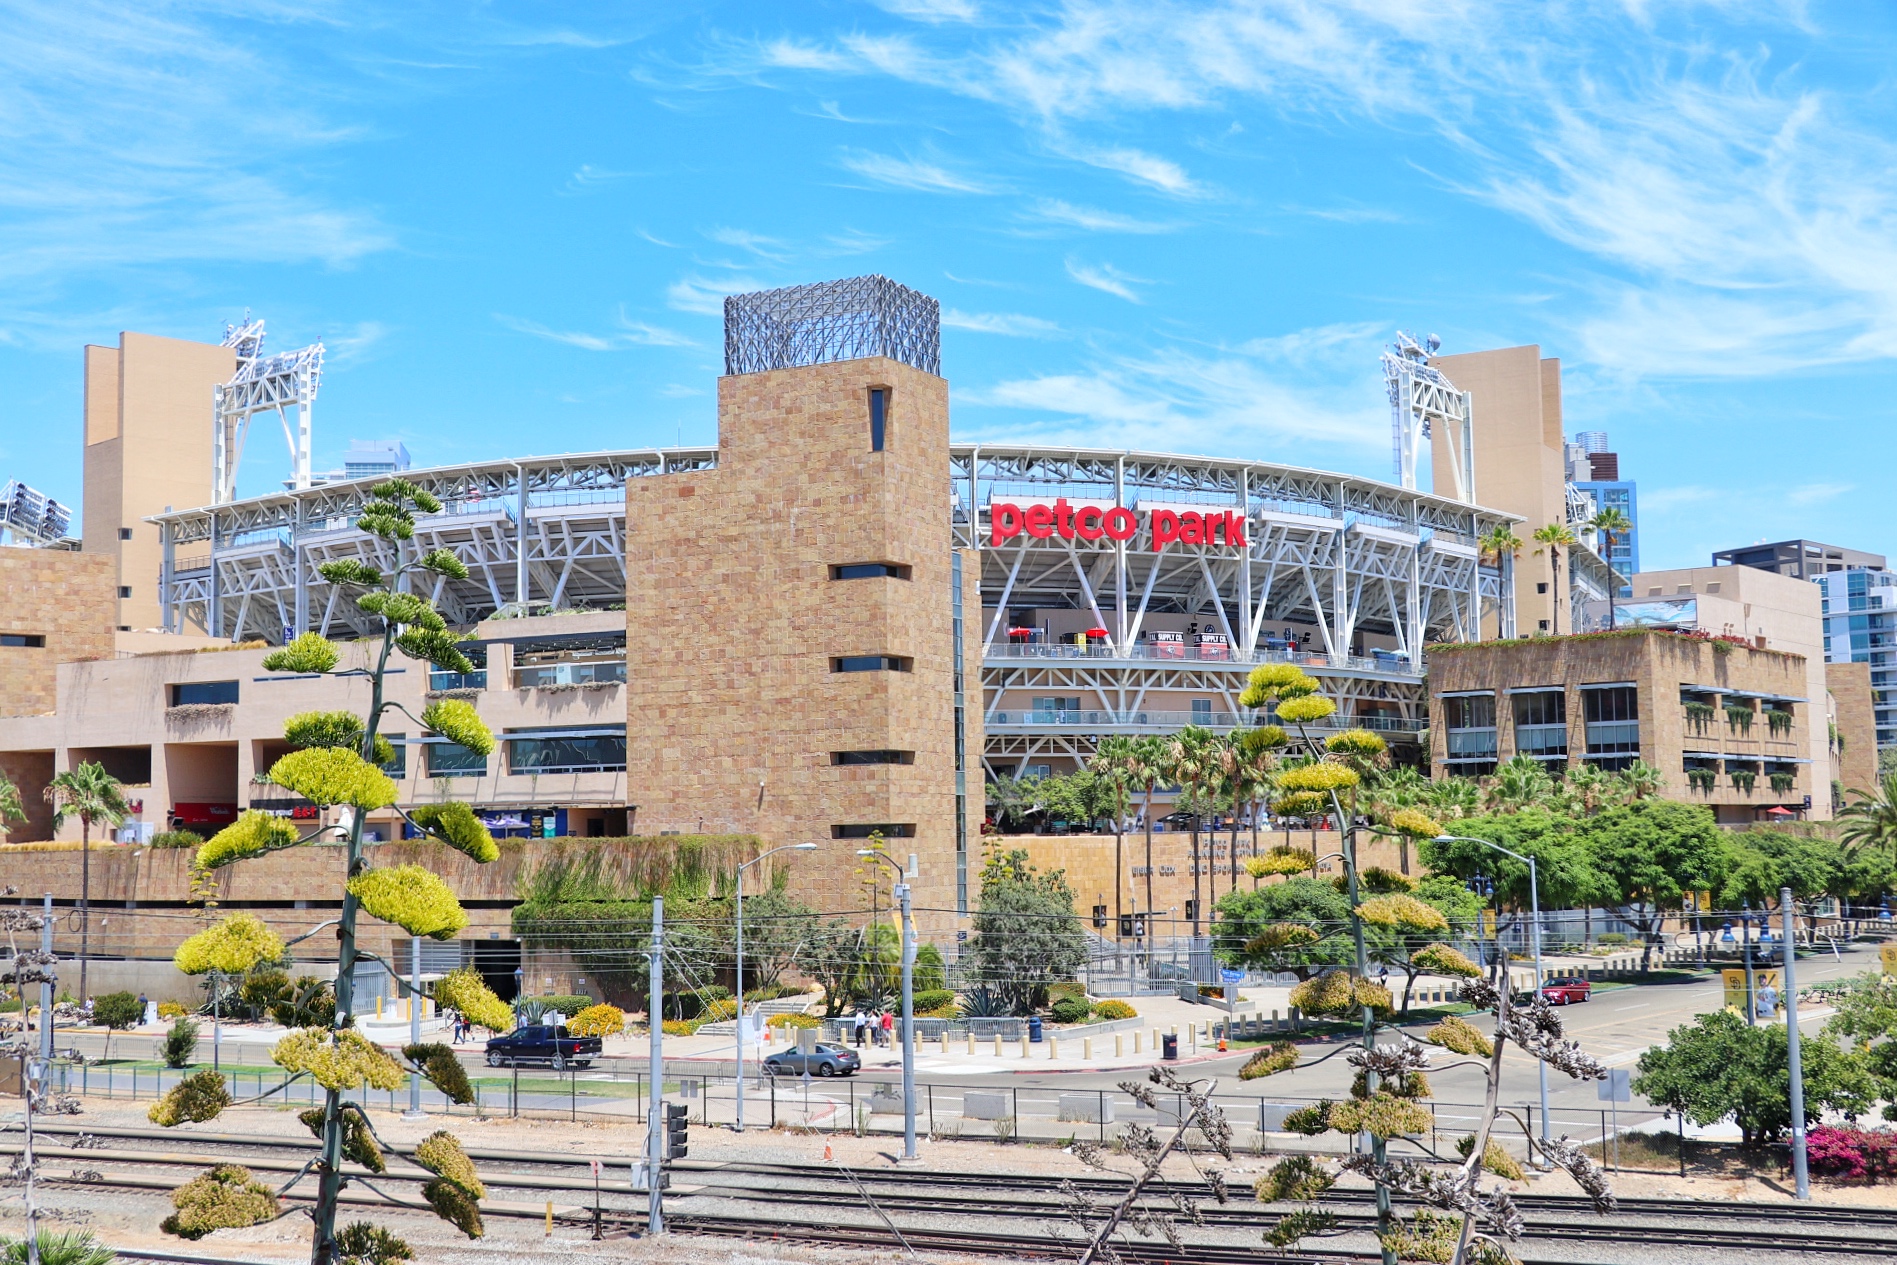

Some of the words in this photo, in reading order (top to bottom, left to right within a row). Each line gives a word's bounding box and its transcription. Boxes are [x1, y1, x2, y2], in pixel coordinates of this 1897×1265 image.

[991, 498, 1137, 547] petco
[1152, 507, 1248, 552] park
[1158, 633, 1175, 641] SUPPLY
[1202, 634, 1219, 643] SUPPLY
